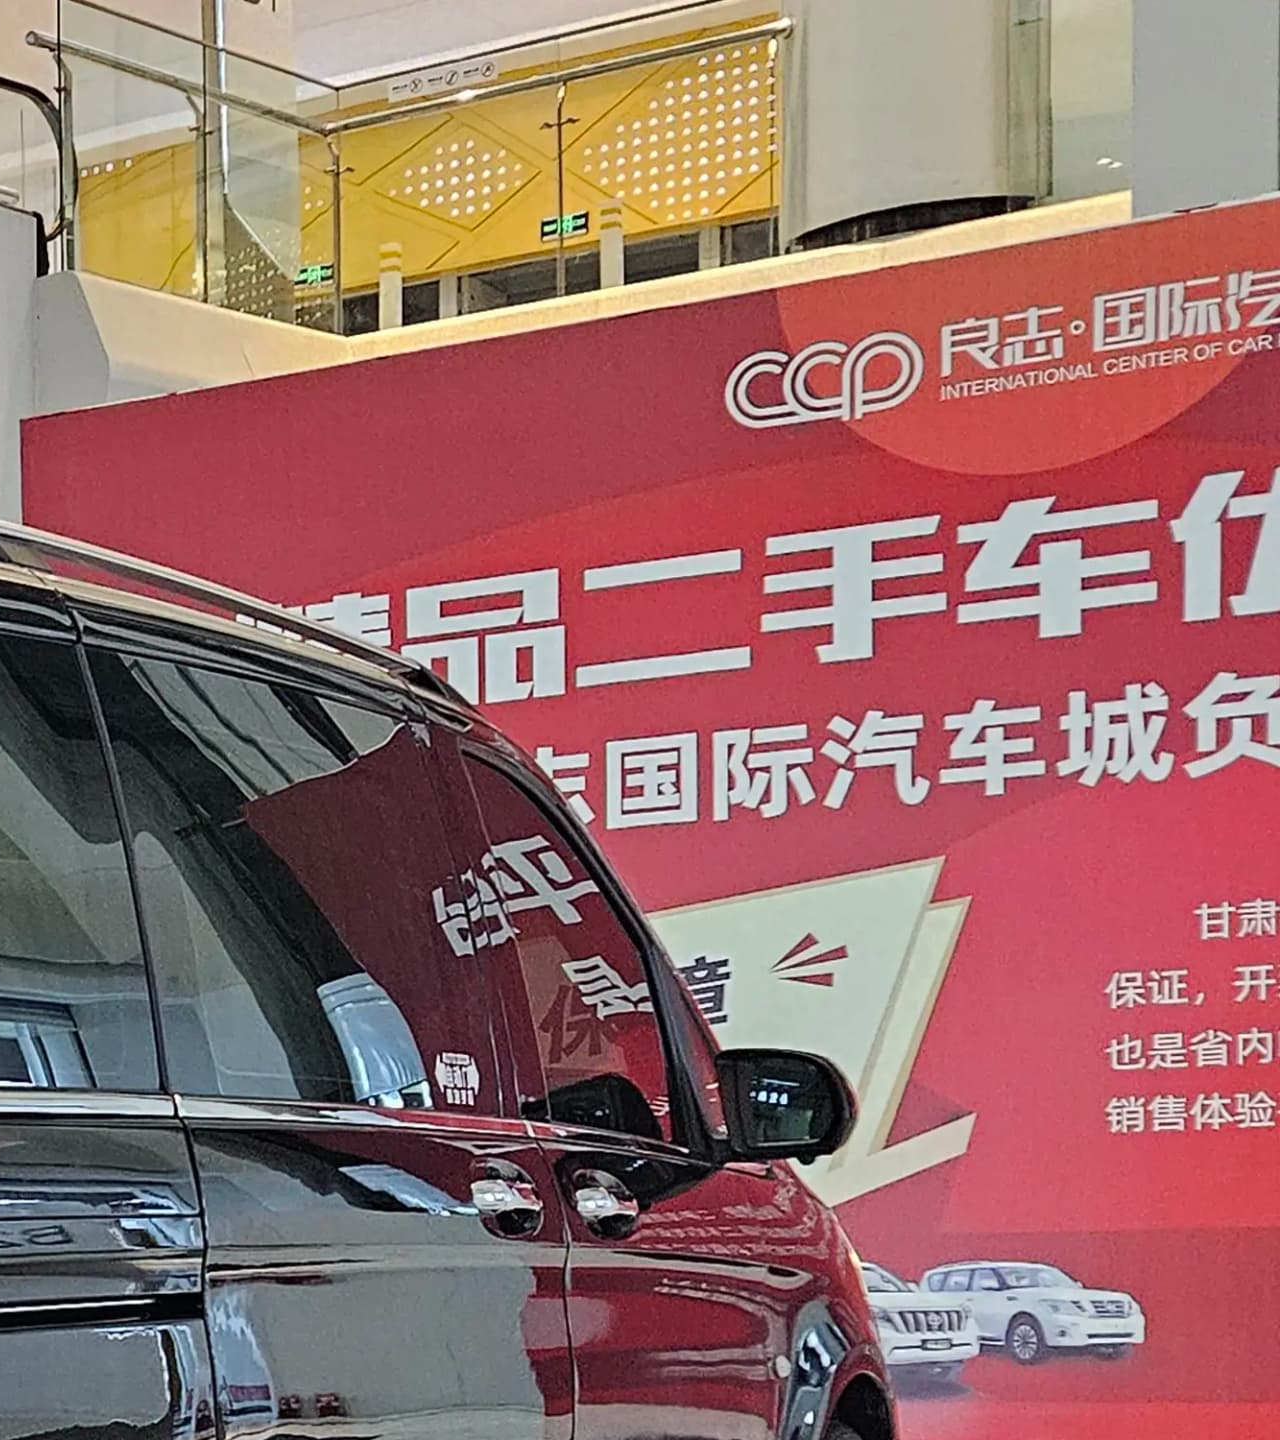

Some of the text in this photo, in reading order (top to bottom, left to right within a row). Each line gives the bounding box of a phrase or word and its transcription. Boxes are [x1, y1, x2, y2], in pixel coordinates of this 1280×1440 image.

[940, 362, 1098, 401] INTERNATIONAL
[1103, 347, 1189, 376] CENTER
[1193, 342, 1224, 362] OF
[1227, 334, 1273, 356] CAR
[1193, 897, 1280, 940] 甘肃
[1104, 963, 1280, 1009] 保证，开
[1105, 1027, 1280, 1070] 也是省内
[1104, 1091, 1280, 1133] 销售体验
